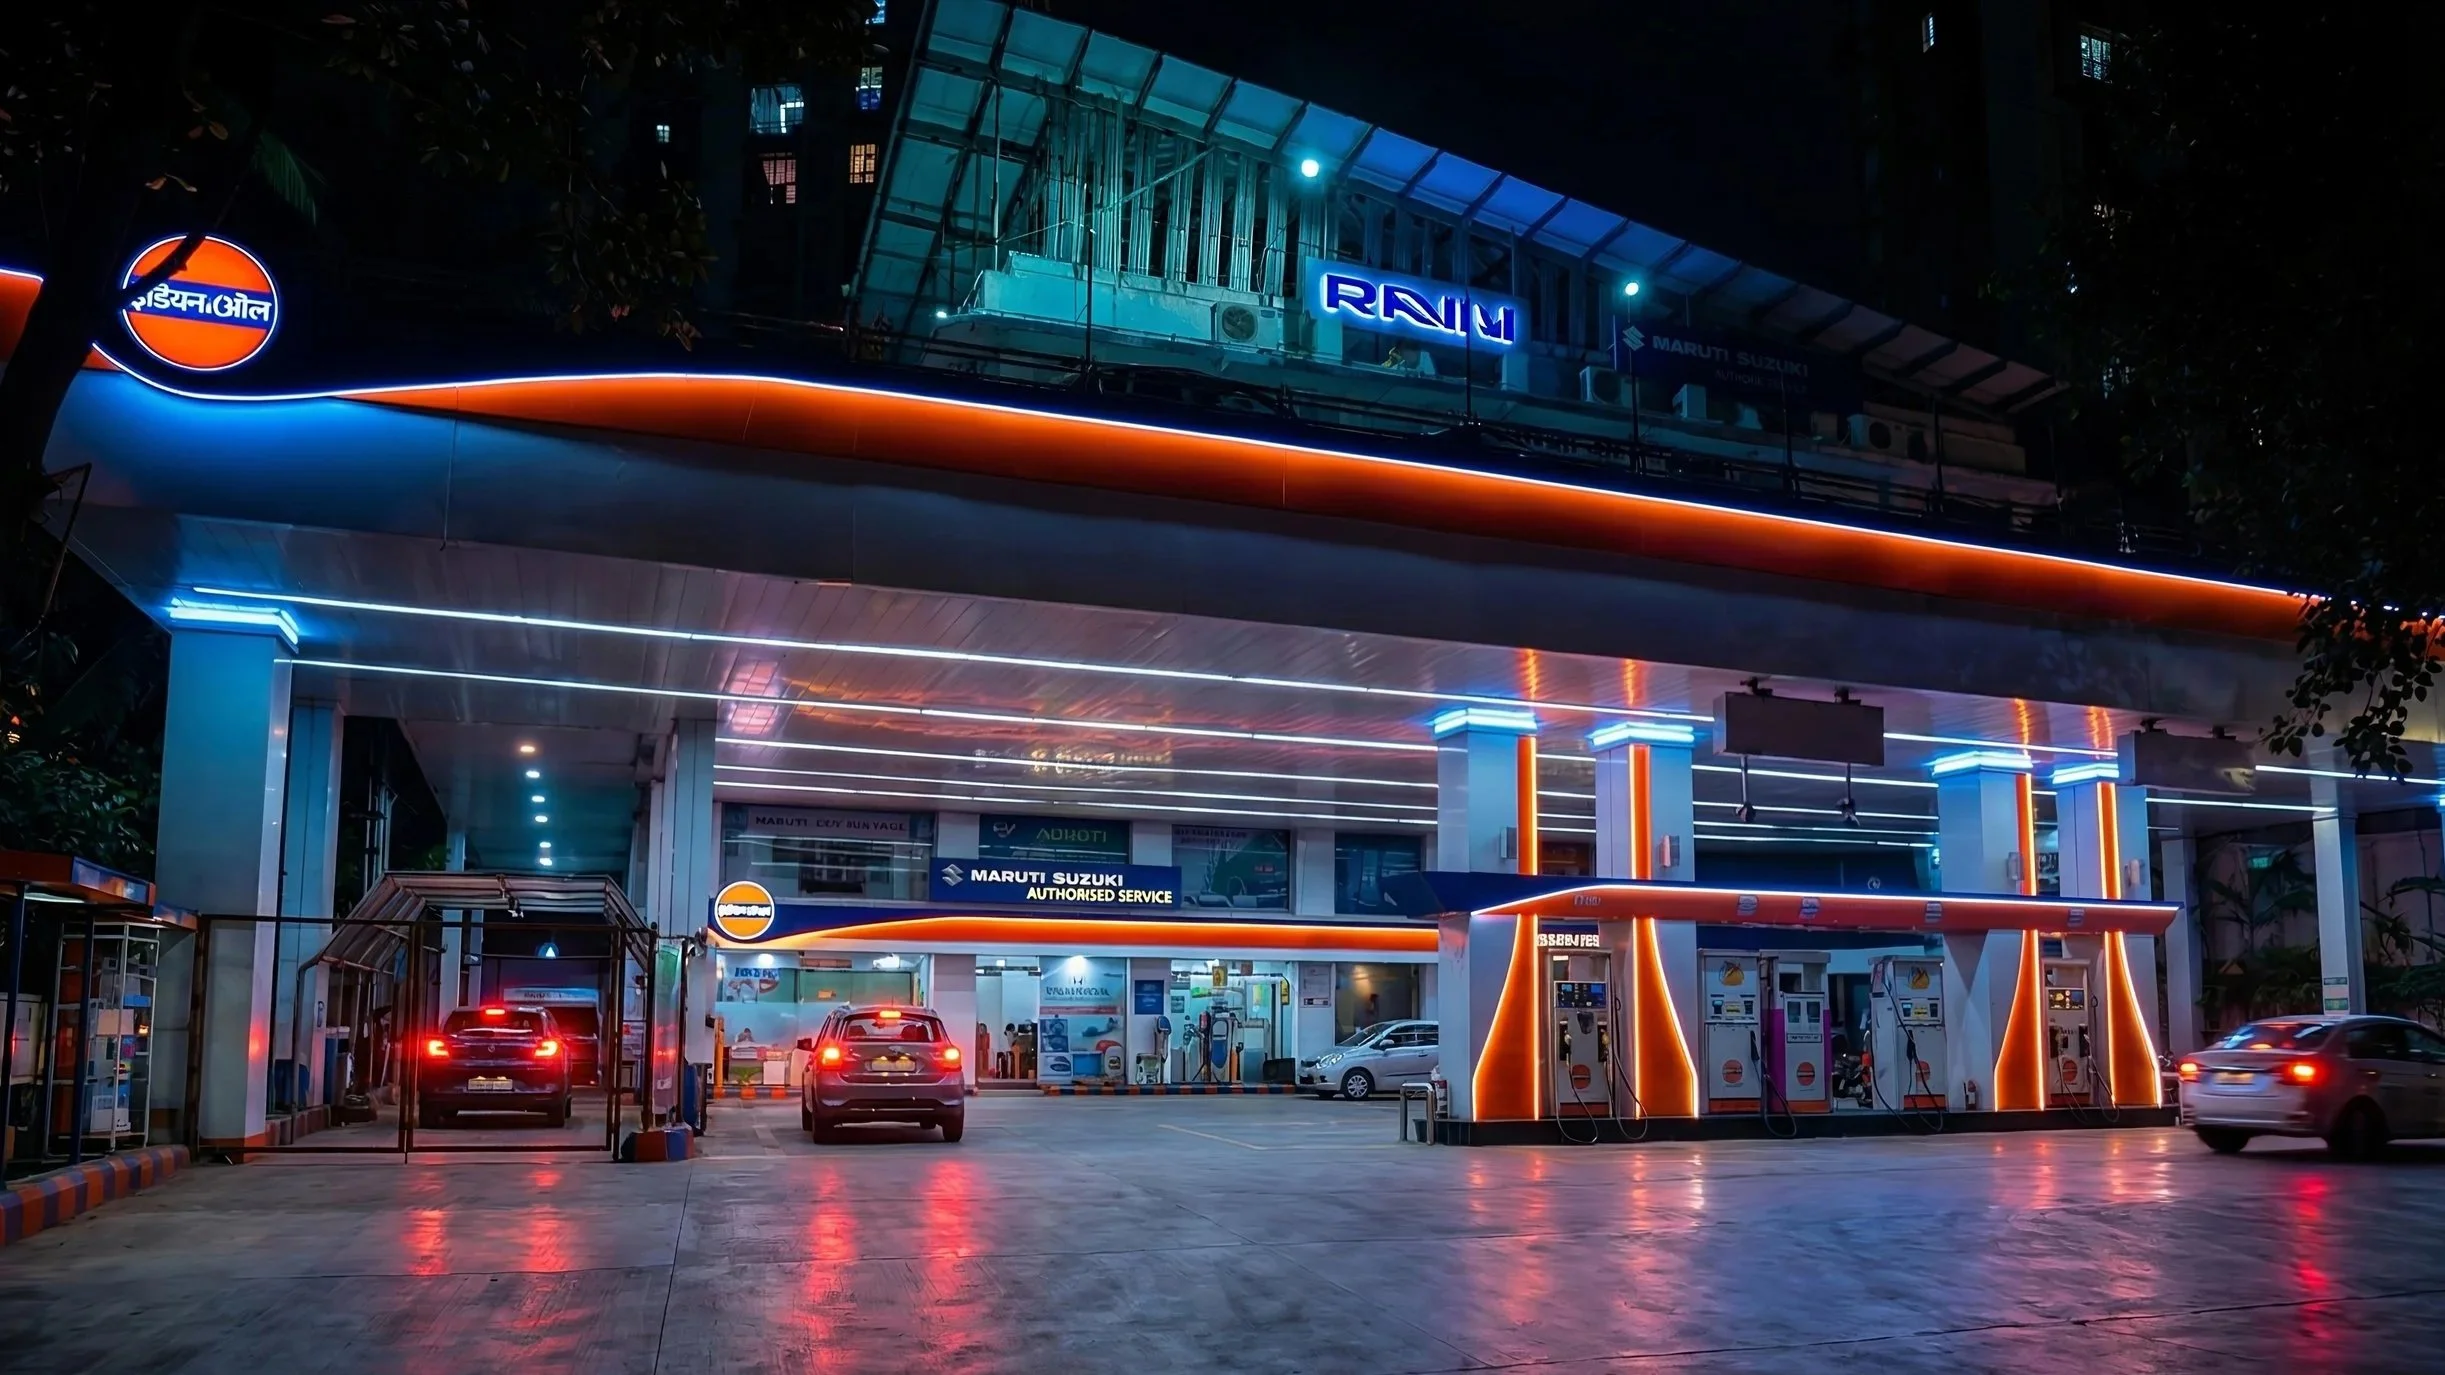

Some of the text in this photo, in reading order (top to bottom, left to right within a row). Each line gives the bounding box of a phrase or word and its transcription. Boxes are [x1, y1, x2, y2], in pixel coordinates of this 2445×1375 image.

[1652, 336, 1809, 379] MARUTI SUZUKI
[970, 869, 1123, 887] MARUTI SUZUKI
[1026, 887, 1173, 904] AUTHORISED SERVICE
